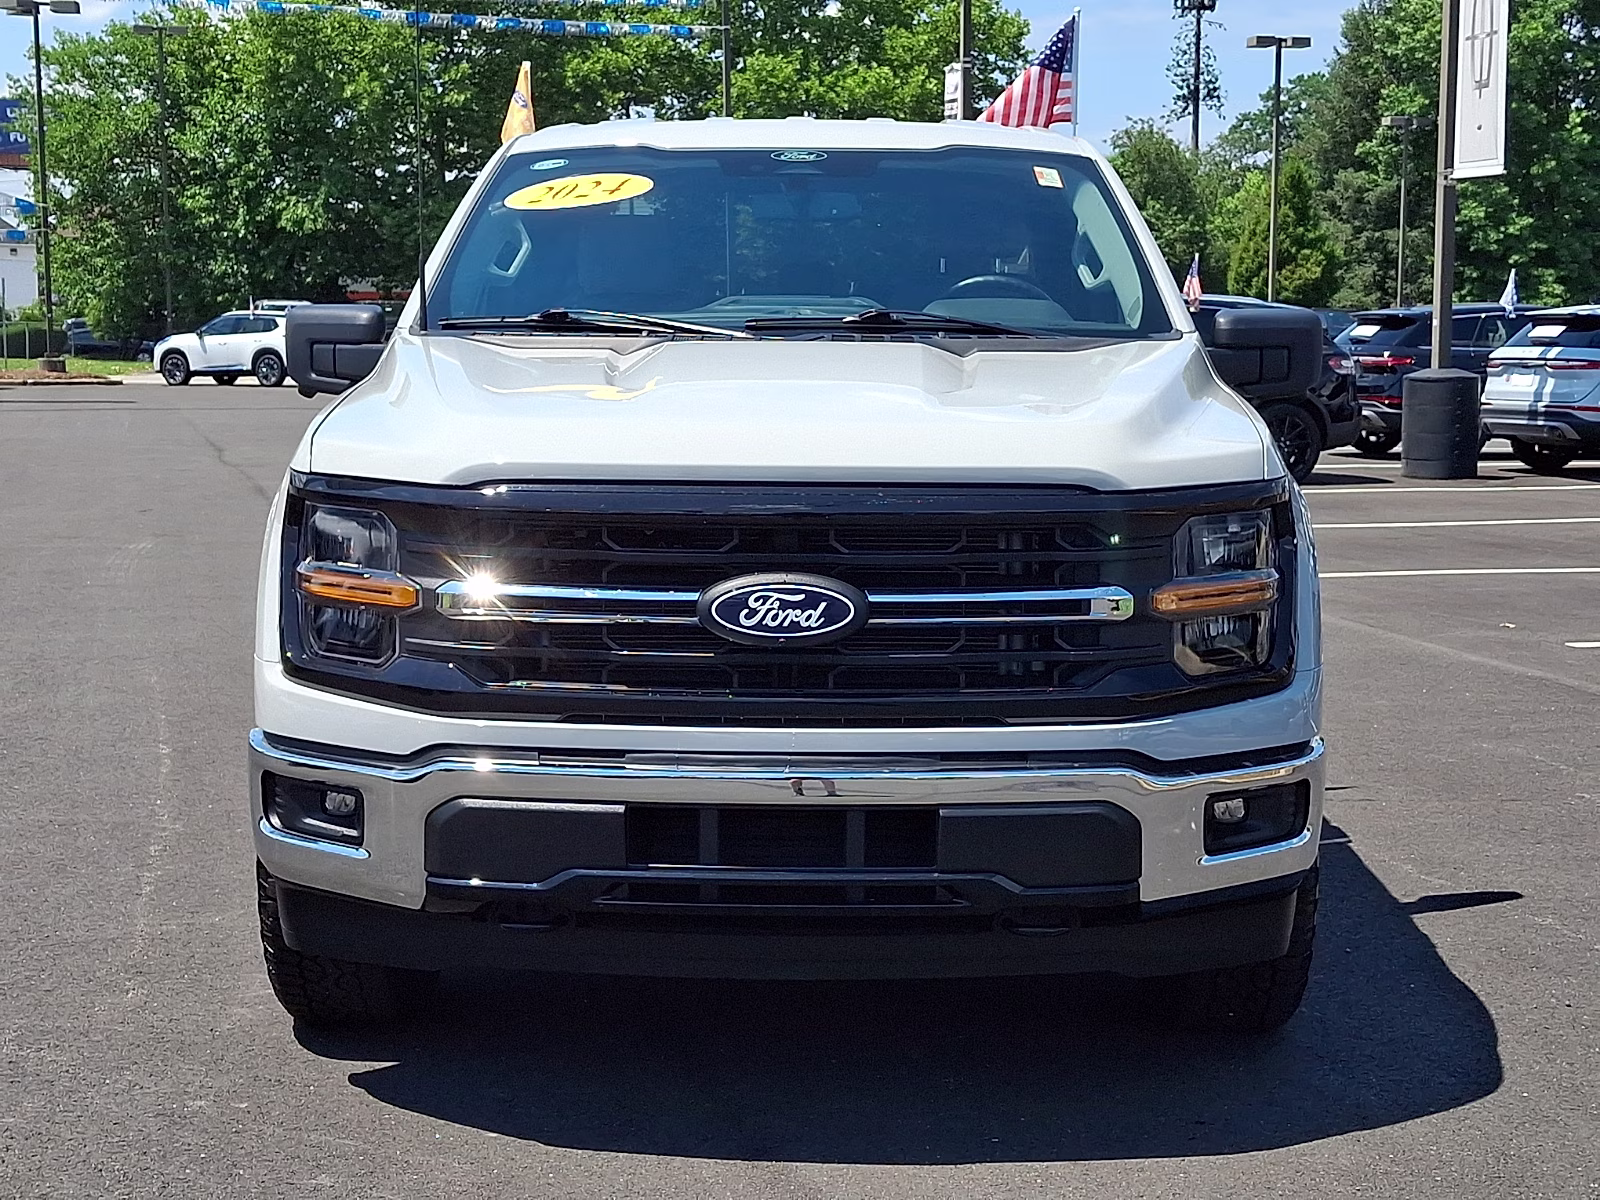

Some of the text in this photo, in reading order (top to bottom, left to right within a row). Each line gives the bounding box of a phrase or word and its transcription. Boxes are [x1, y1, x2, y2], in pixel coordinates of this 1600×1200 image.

[780, 150, 817, 160] Ford
[526, 177, 632, 204] 2024
[738, 591, 828, 628] Ford
